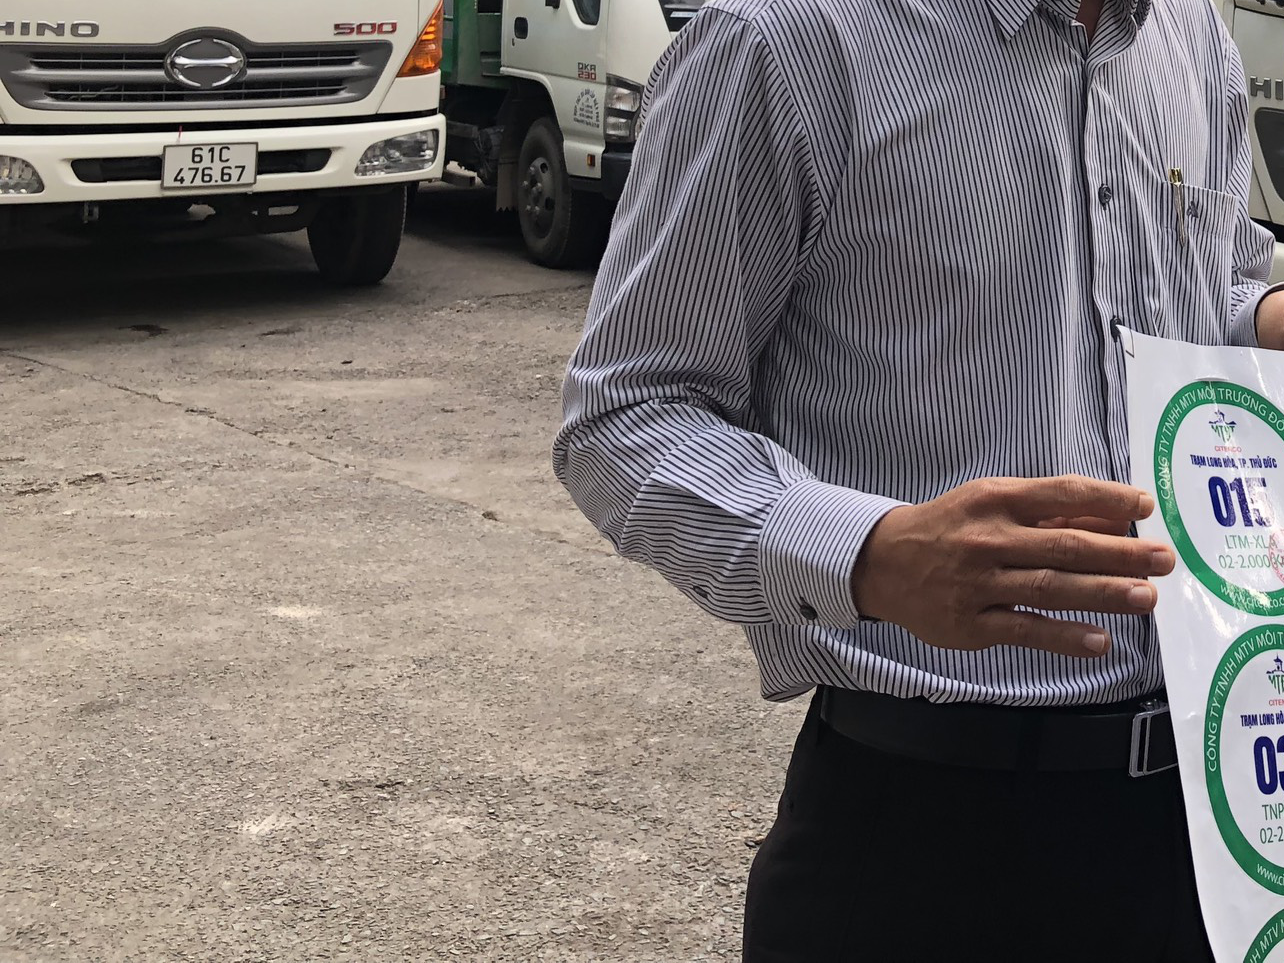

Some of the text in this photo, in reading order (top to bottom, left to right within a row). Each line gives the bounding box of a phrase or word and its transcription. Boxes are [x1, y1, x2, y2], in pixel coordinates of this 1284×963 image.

[333, 21, 398, 36] 500
[190, 146, 230, 164] 61C
[173, 164, 246, 185] 476.67
[1179, 390, 1197, 410] MTV
[1218, 388, 1268, 416] TRƯỜNG
[1163, 404, 1183, 436] TNHH
[1268, 412, 1284, 431] ĐÔ
[1159, 436, 1170, 453] TY
[1208, 457, 1222, 467] LONG
[1250, 455, 1262, 468] THỦ
[1263, 456, 1277, 468] ĐỨC
[1256, 629, 1276, 648] MÔI
[1234, 639, 1254, 662] MTV
[1214, 658, 1237, 697] TNHH
[1210, 698, 1221, 718] TY
[1240, 713, 1258, 729] TRẠM
[1260, 713, 1274, 726] LONG
[1206, 721, 1218, 772] CÔNG
[1260, 922, 1278, 953] MTV
